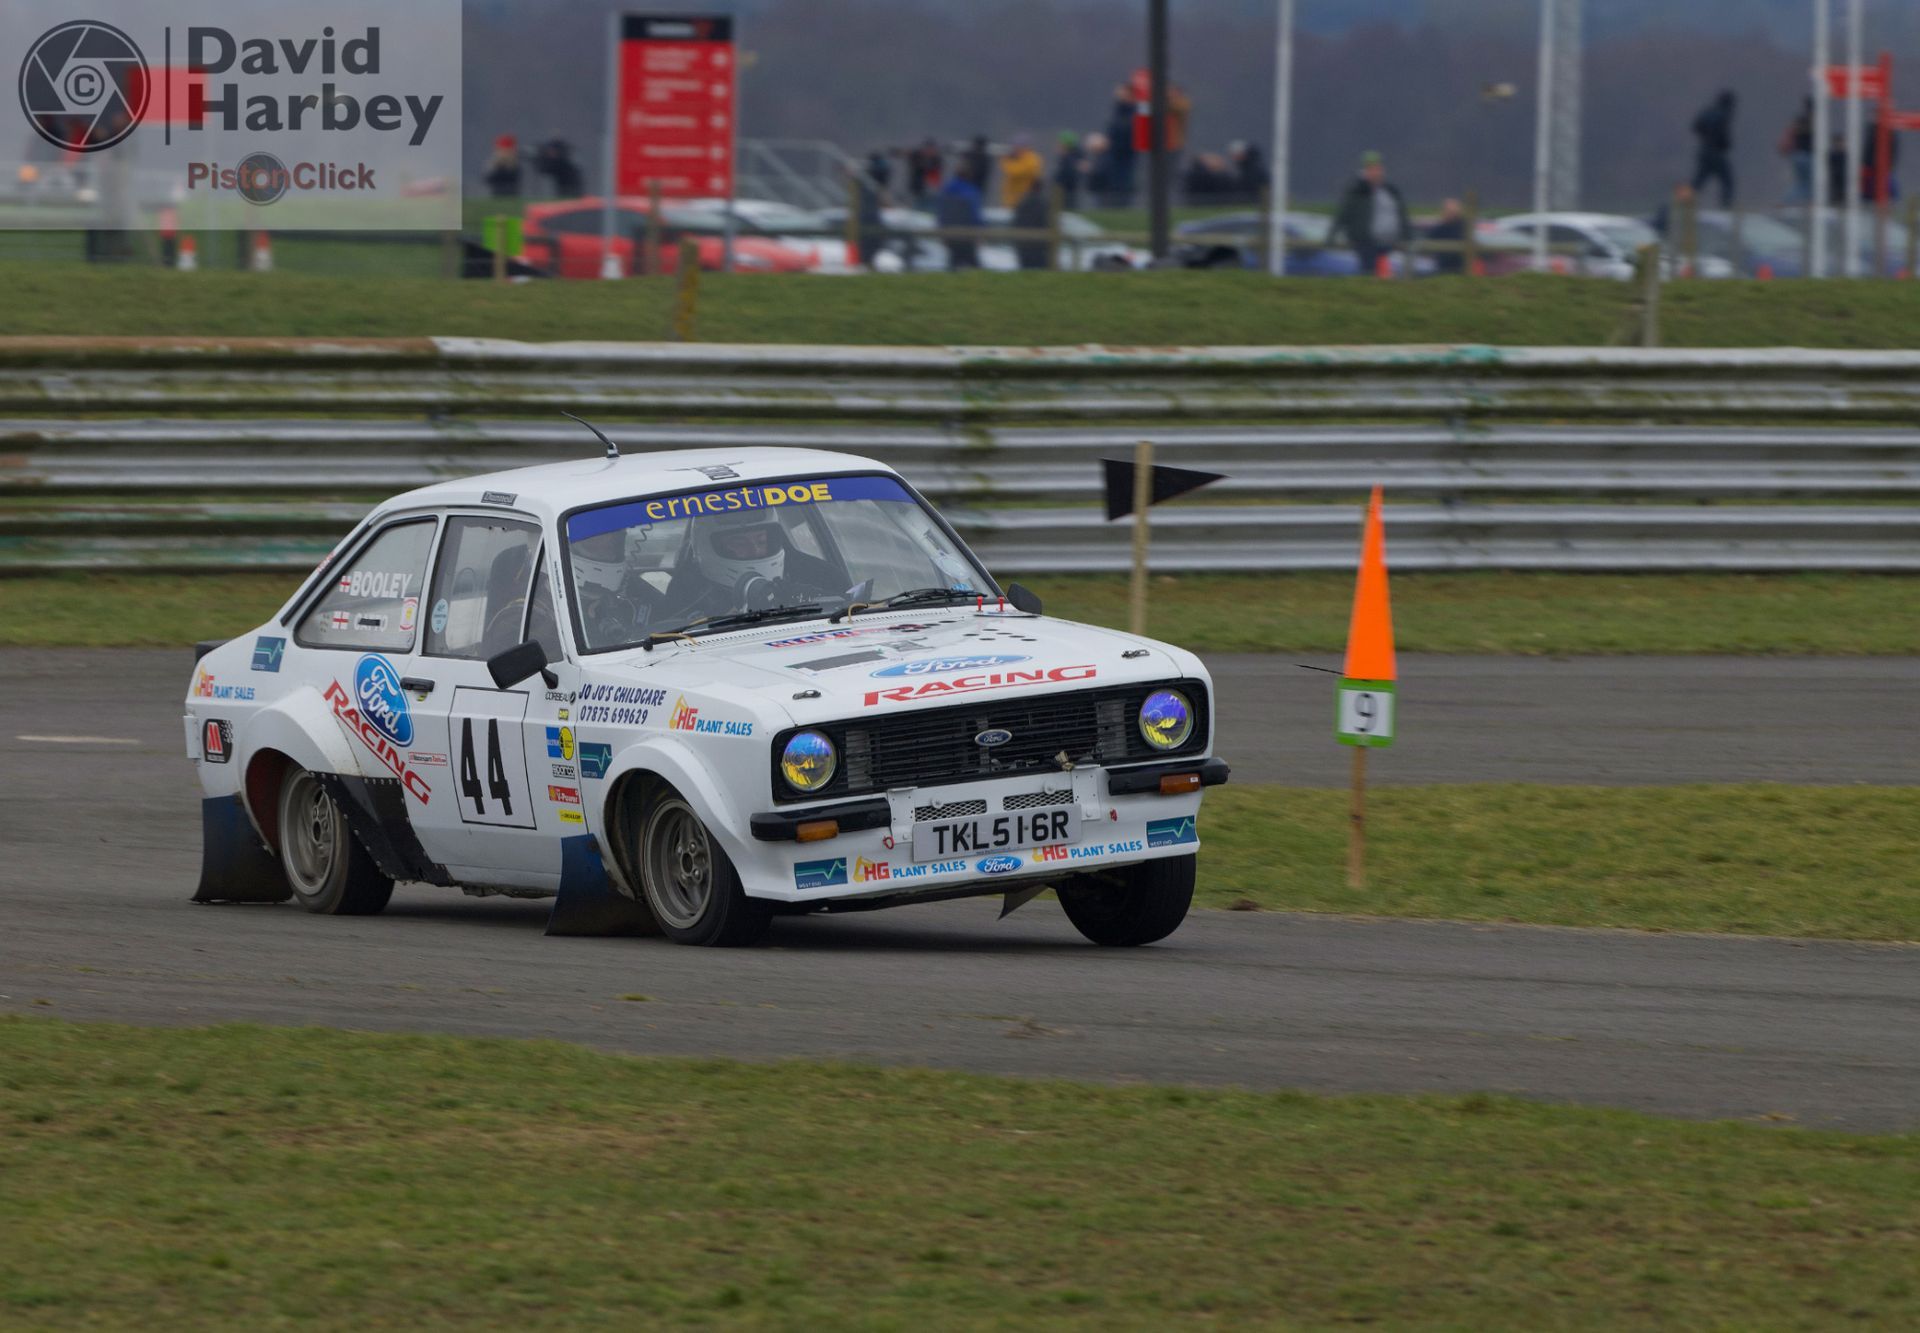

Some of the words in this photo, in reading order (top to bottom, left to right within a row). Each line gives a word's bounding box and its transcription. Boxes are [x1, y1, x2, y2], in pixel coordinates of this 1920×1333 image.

[646, 487, 758, 520] ernest
[765, 483, 832, 506] DOE
[350, 571, 413, 599] BOOLEY
[903, 655, 1003, 675] Ford
[214, 685, 233, 699] PLANT
[234, 686, 255, 700] SALES
[360, 665, 400, 735] Ford
[578, 683, 592, 700] JO
[613, 686, 666, 706] CHILDCARE
[863, 664, 1097, 707] RACING
[580, 705, 609, 722] 07875
[611, 708, 649, 725] 699629
[676, 707, 698, 731] HG
[696, 719, 722, 733] PLANT
[726, 721, 753, 737] SALES
[1354, 692, 1377, 733] 9
[322, 679, 432, 806] RACING
[460, 717, 513, 816] 44
[932, 809, 1069, 855] TKL516R
[984, 857, 1015, 873] Ford
[1043, 844, 1068, 861] HG
[1070, 847, 1105, 859] PLANT
[1109, 840, 1143, 853] SALES
[864, 861, 891, 882] HG
[893, 864, 927, 878] PLANT
[932, 860, 967, 874] SALES
